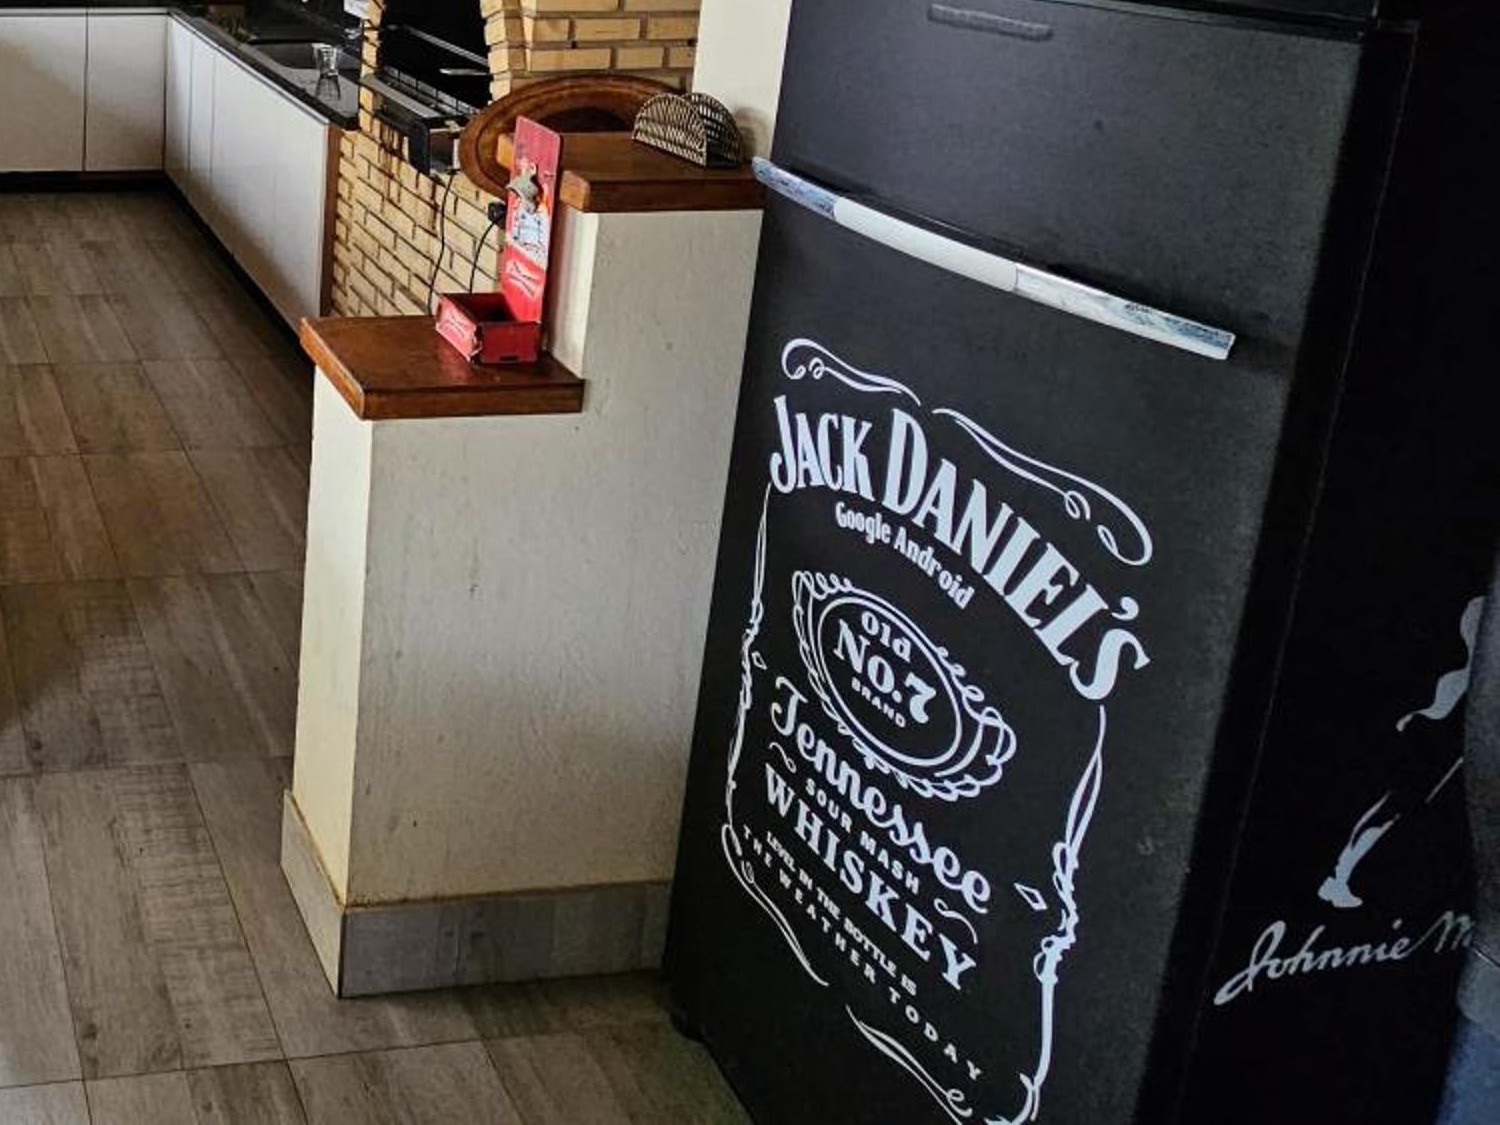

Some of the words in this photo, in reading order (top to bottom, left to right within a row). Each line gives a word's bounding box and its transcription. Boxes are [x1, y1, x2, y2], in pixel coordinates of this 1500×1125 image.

[769, 395, 876, 502] JACK
[882, 408, 1150, 699] DANIEL'S
[836, 502, 891, 544] Google
[894, 528, 974, 609] Android
[862, 610, 914, 662] Old
[852, 678, 905, 727] BRAND
[771, 678, 990, 913] Tennessee
[806, 778, 852, 833] SOUR
[860, 831, 919, 894] MASH
[766, 763, 976, 990] WHISKEY
[799, 869, 812, 890] IN
[817, 887, 840, 920] THE
[844, 917, 896, 977] BOTTLE
[901, 974, 916, 995] IS
[744, 825, 772, 867] THE
[780, 865, 875, 983] WEATHER
[889, 987, 981, 1080] TODAY
[1214, 920, 1409, 1005] Johnnie
